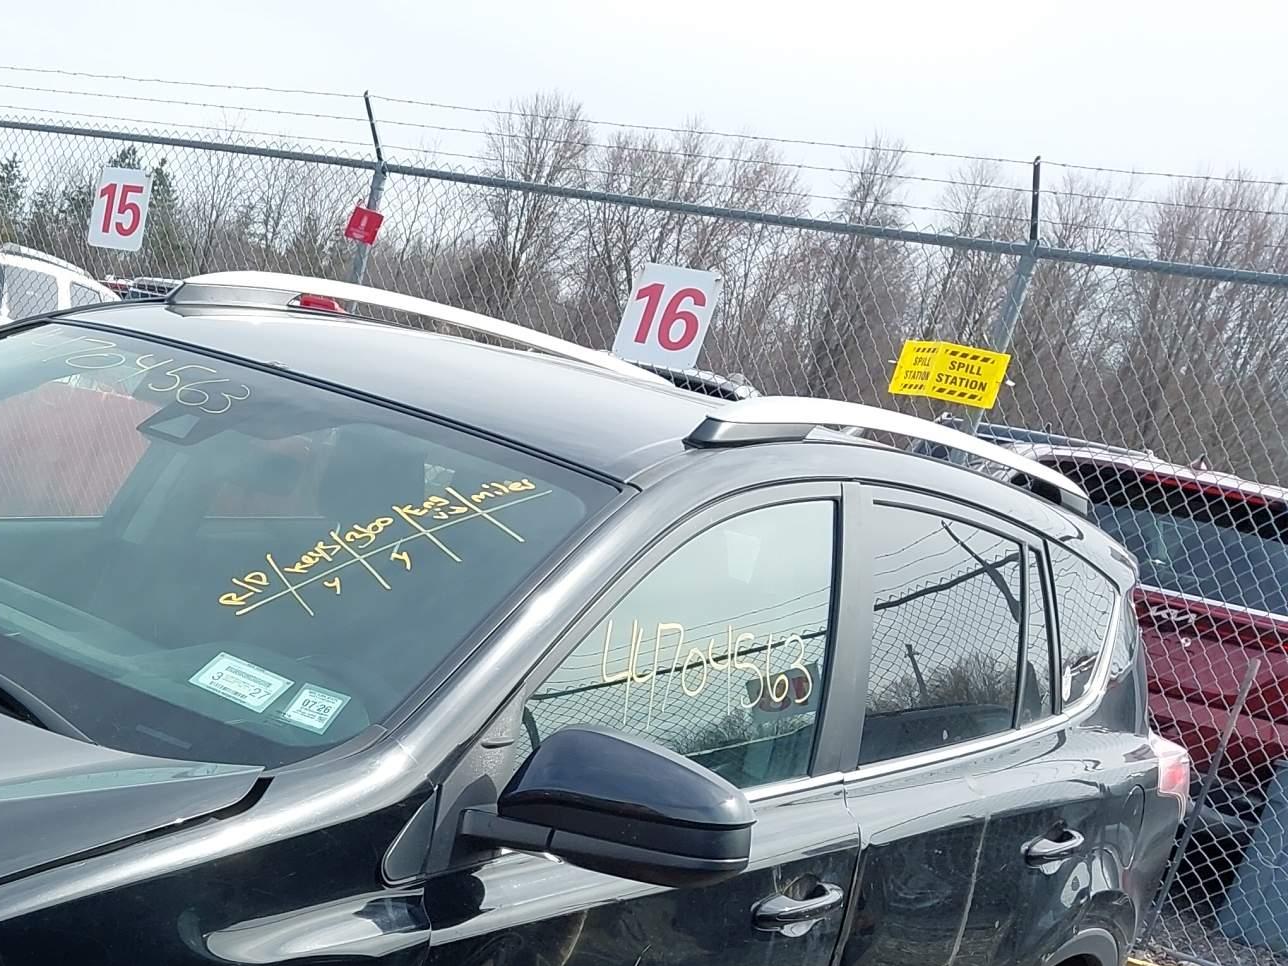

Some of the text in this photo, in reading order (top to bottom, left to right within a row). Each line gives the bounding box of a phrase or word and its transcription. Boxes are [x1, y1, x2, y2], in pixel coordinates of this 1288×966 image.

[100, 183, 144, 236] 15
[634, 283, 707, 351] 16
[913, 356, 931, 367] SPILL
[948, 360, 983, 377] SPILL
[935, 372, 988, 393] STATION
[249, 687, 272, 700] 27
[301, 698, 316, 710] 07
